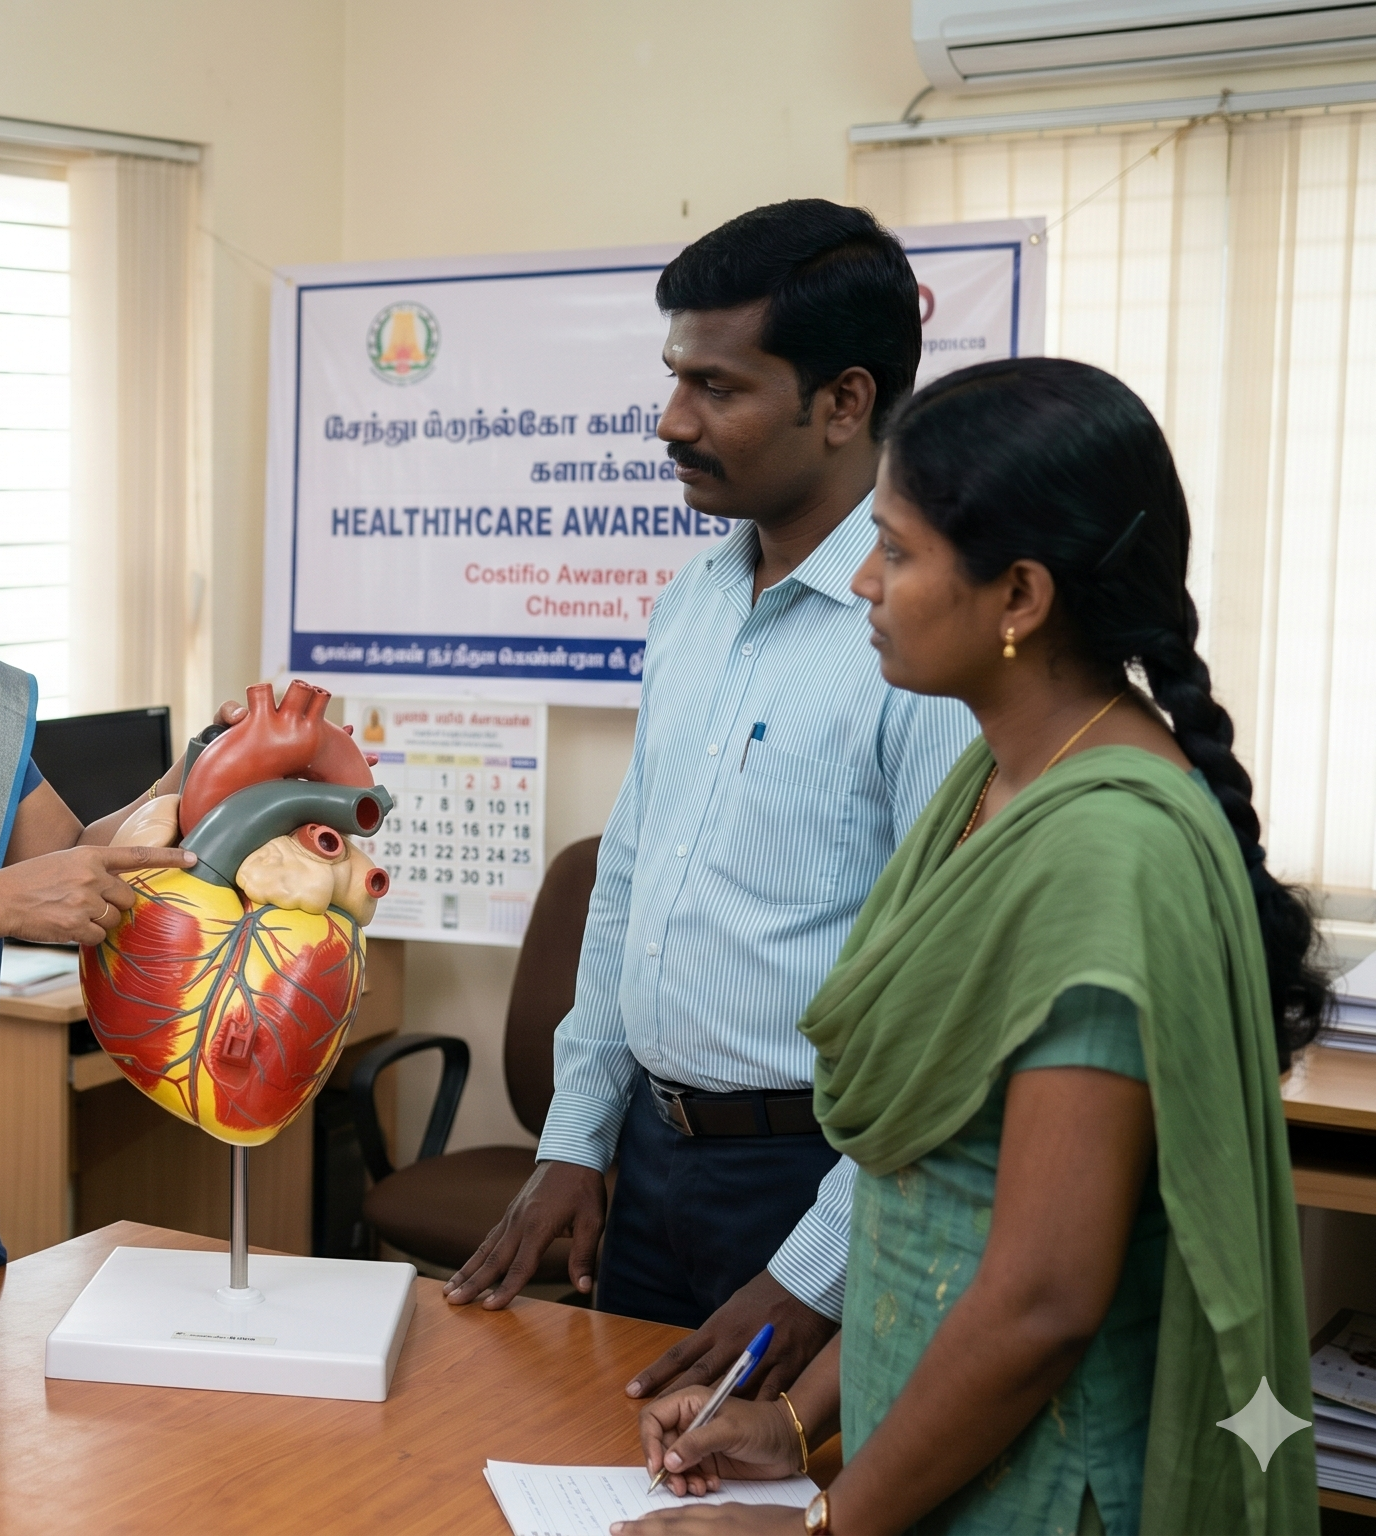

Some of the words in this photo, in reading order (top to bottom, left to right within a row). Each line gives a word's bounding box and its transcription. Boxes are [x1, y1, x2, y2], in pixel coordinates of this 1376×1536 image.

[557, 564, 648, 585] Awarera
[441, 773, 448, 788] 1
[465, 774, 475, 789] 2
[491, 775, 501, 791] 3
[517, 776, 528, 791] 4
[415, 796, 423, 810] 7
[440, 797, 449, 812] 8
[465, 798, 475, 813] 9
[488, 800, 505, 814] 10
[514, 801, 530, 815] 11
[385, 818, 402, 833] 13
[411, 819, 428, 834] 14
[437, 820, 454, 836] 15
[462, 822, 479, 837] 16
[488, 824, 505, 838] 17
[513, 825, 531, 840] 18
[384, 842, 402, 856] 20
[409, 843, 427, 858] 21
[435, 844, 453, 859] 22
[461, 845, 479, 861] 23
[486, 847, 505, 862] 24
[512, 848, 530, 863] 25
[409, 866, 427, 881] 28
[435, 867, 453, 882] 29
[461, 869, 479, 884] 30
[486, 871, 504, 886] 31
